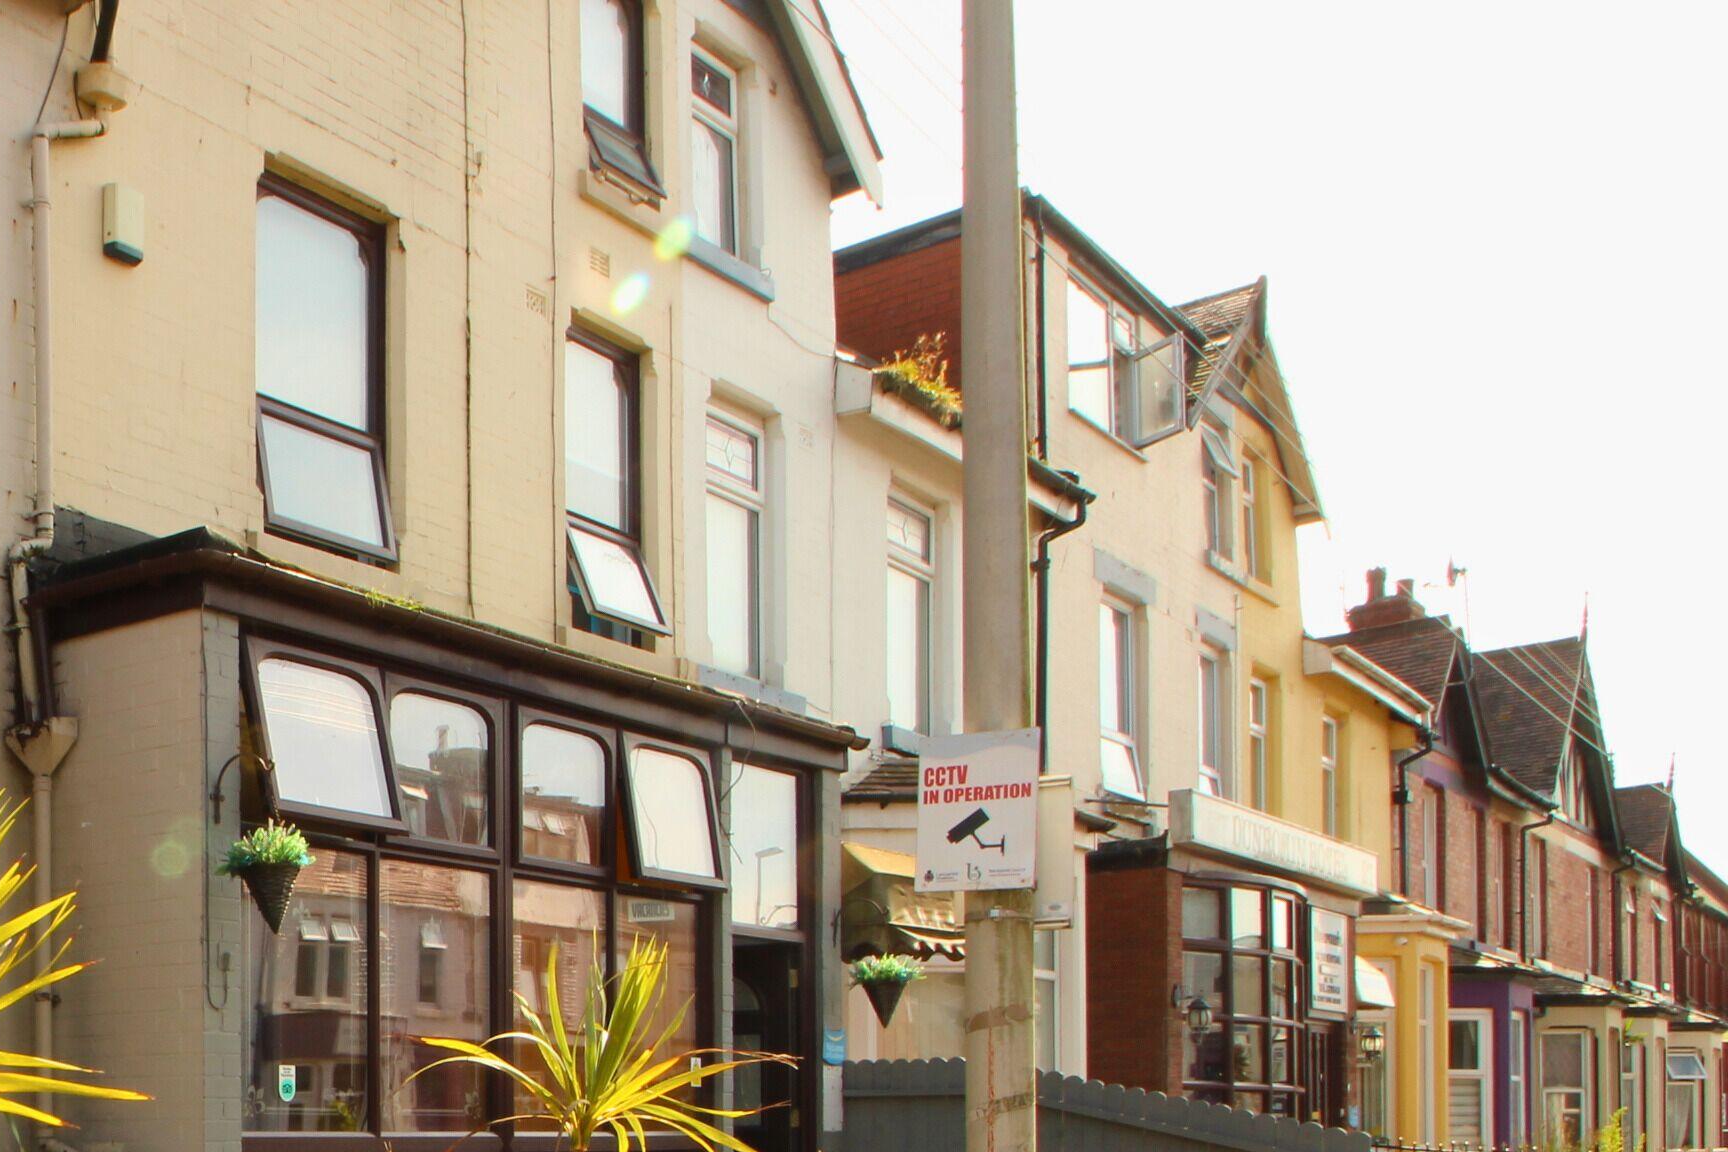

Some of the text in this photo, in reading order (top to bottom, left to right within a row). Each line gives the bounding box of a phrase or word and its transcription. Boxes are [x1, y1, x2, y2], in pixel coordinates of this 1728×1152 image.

[923, 764, 968, 787] CCTV
[923, 783, 1032, 805] IN OPERATION
